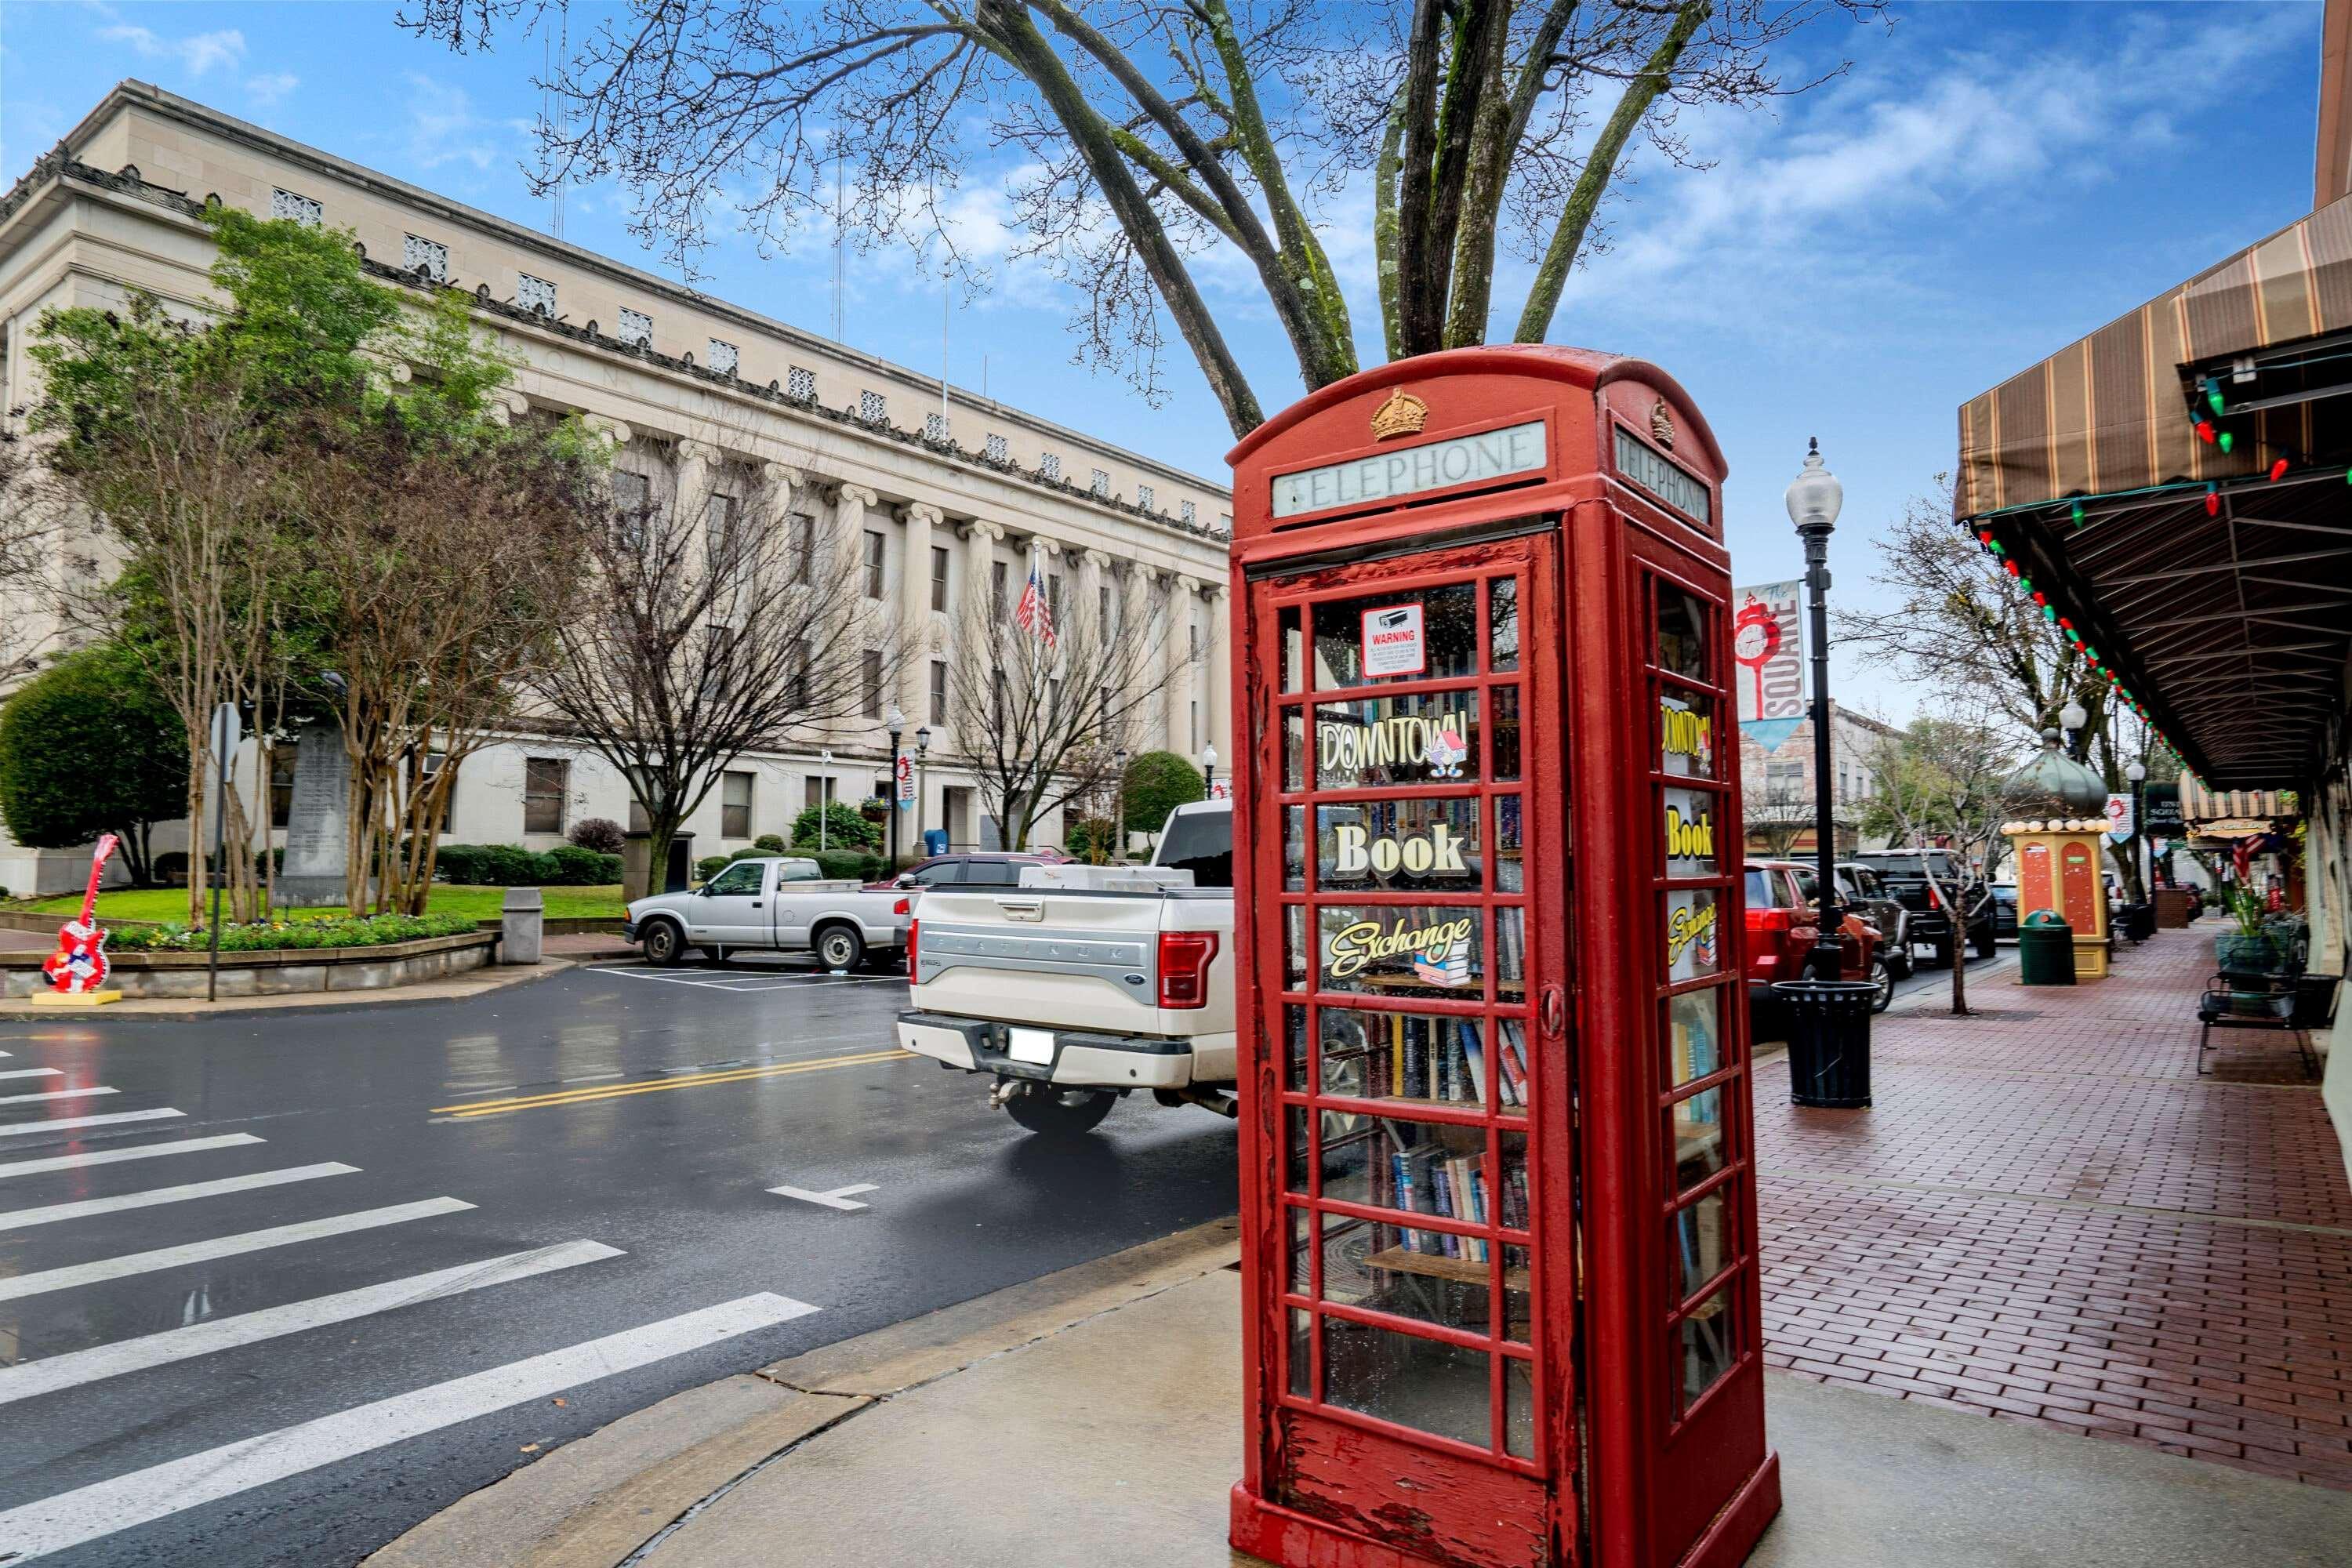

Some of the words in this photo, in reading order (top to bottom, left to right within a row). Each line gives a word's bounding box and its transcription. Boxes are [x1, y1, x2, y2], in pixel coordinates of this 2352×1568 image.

[1283, 430, 1534, 510] TELEPHONE
[1766, 583, 1788, 601] The
[1372, 630, 1414, 645] WARNING
[1765, 599, 1802, 717] SQUARE
[1320, 710, 1467, 771] DOWNTOWN
[1334, 823, 1466, 872] Book
[1667, 809, 1714, 855] Book
[934, 938, 1123, 960] PLATINUM
[1330, 917, 1472, 978] Exchange
[1668, 902, 1716, 966] Exchange
